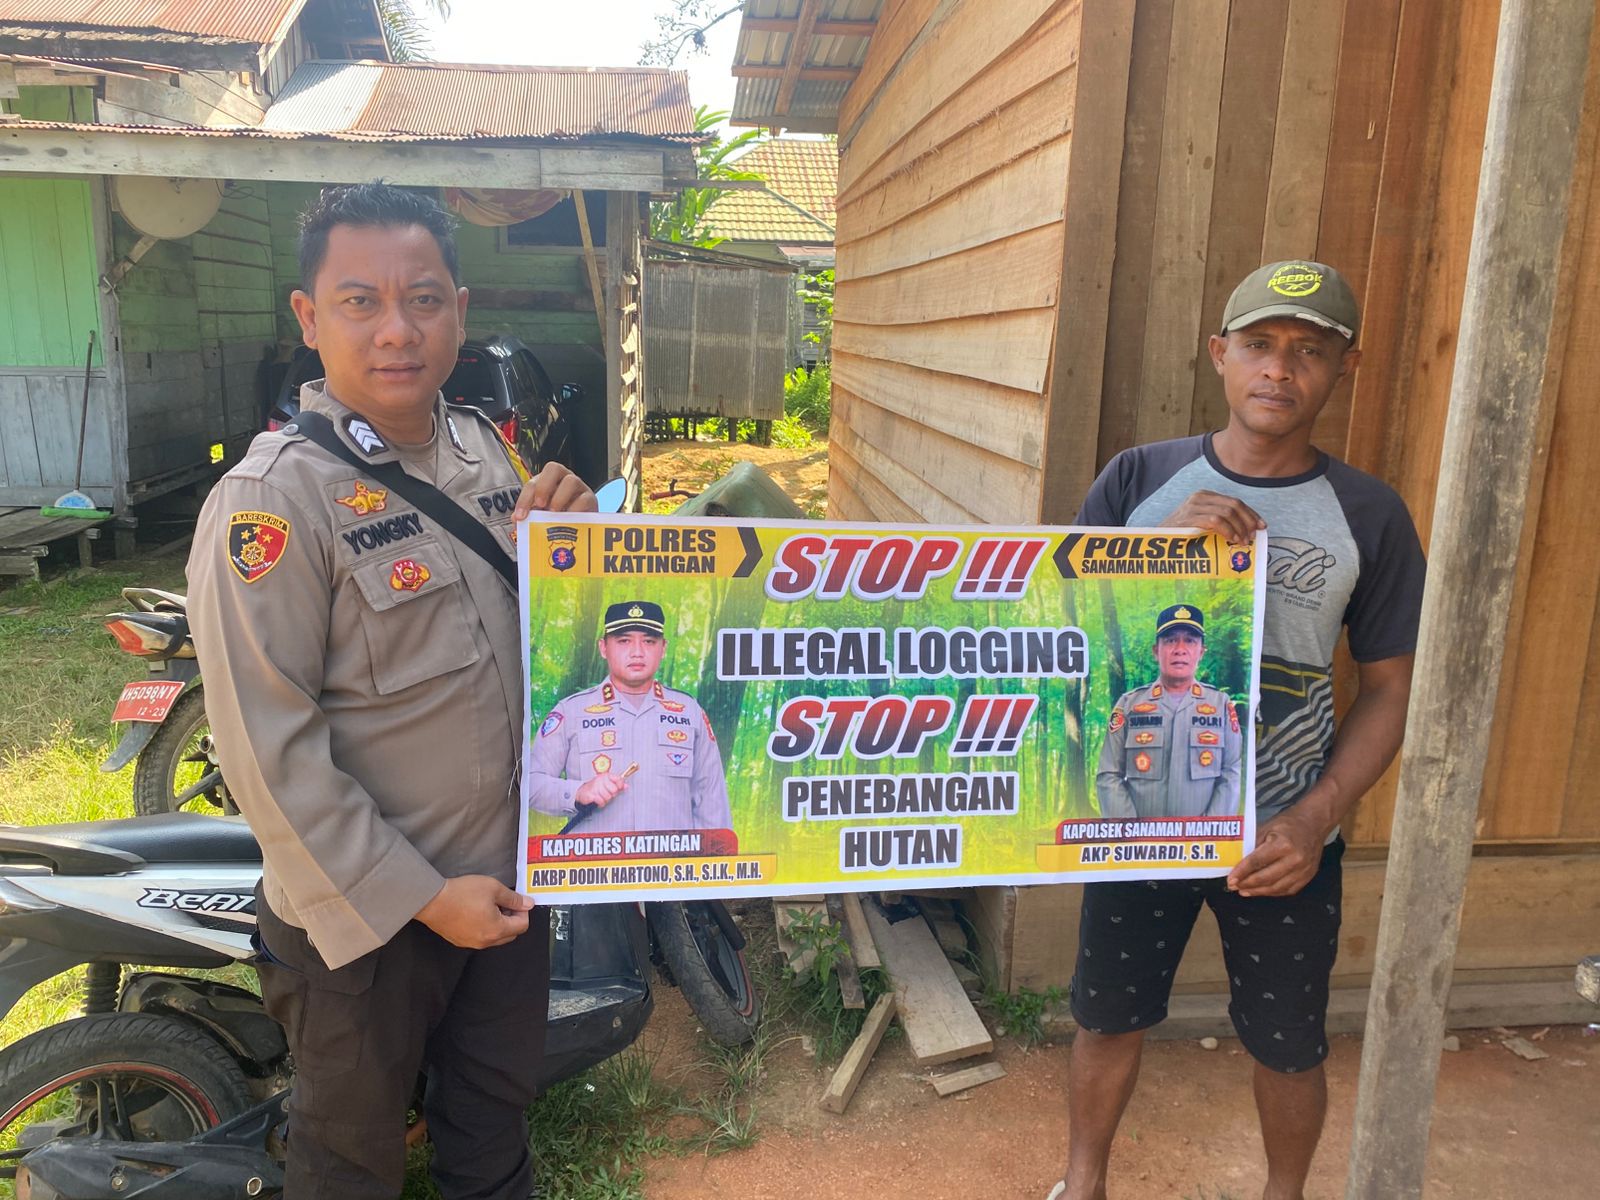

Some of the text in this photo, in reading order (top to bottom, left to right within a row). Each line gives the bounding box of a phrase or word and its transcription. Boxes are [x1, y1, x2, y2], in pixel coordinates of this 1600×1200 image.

[1267, 273, 1323, 288] REEBOK
[236, 513, 285, 530] BARESKRIM
[342, 512, 424, 555] YONGKY
[603, 527, 717, 554] POLRES
[1082, 536, 1210, 560] POLSEK
[603, 554, 716, 574] KATINGAN
[771, 536, 1048, 595] STOP !!!
[1081, 557, 1212, 575] SANAMAN MANTIKEI
[721, 630, 1085, 676] ILLEGAL LOGGING
[582, 717, 616, 729] DODIK
[660, 714, 691, 726] POLRI
[771, 698, 1035, 757] STOP !!!
[1192, 716, 1222, 727] POLRI
[786, 775, 1016, 818] PENEBANGAN
[1062, 820, 1241, 840] KAPOLSEK SANAMAN MANTIKEI
[542, 834, 701, 857] KAPOLRES KATINGAN
[843, 828, 959, 868] HUTAN
[1081, 844, 1219, 862] AKP SUWARDI, S.H.
[531, 862, 762, 887] AKBP DODIK HARTONO, S.H., S.I.K., M.H.
